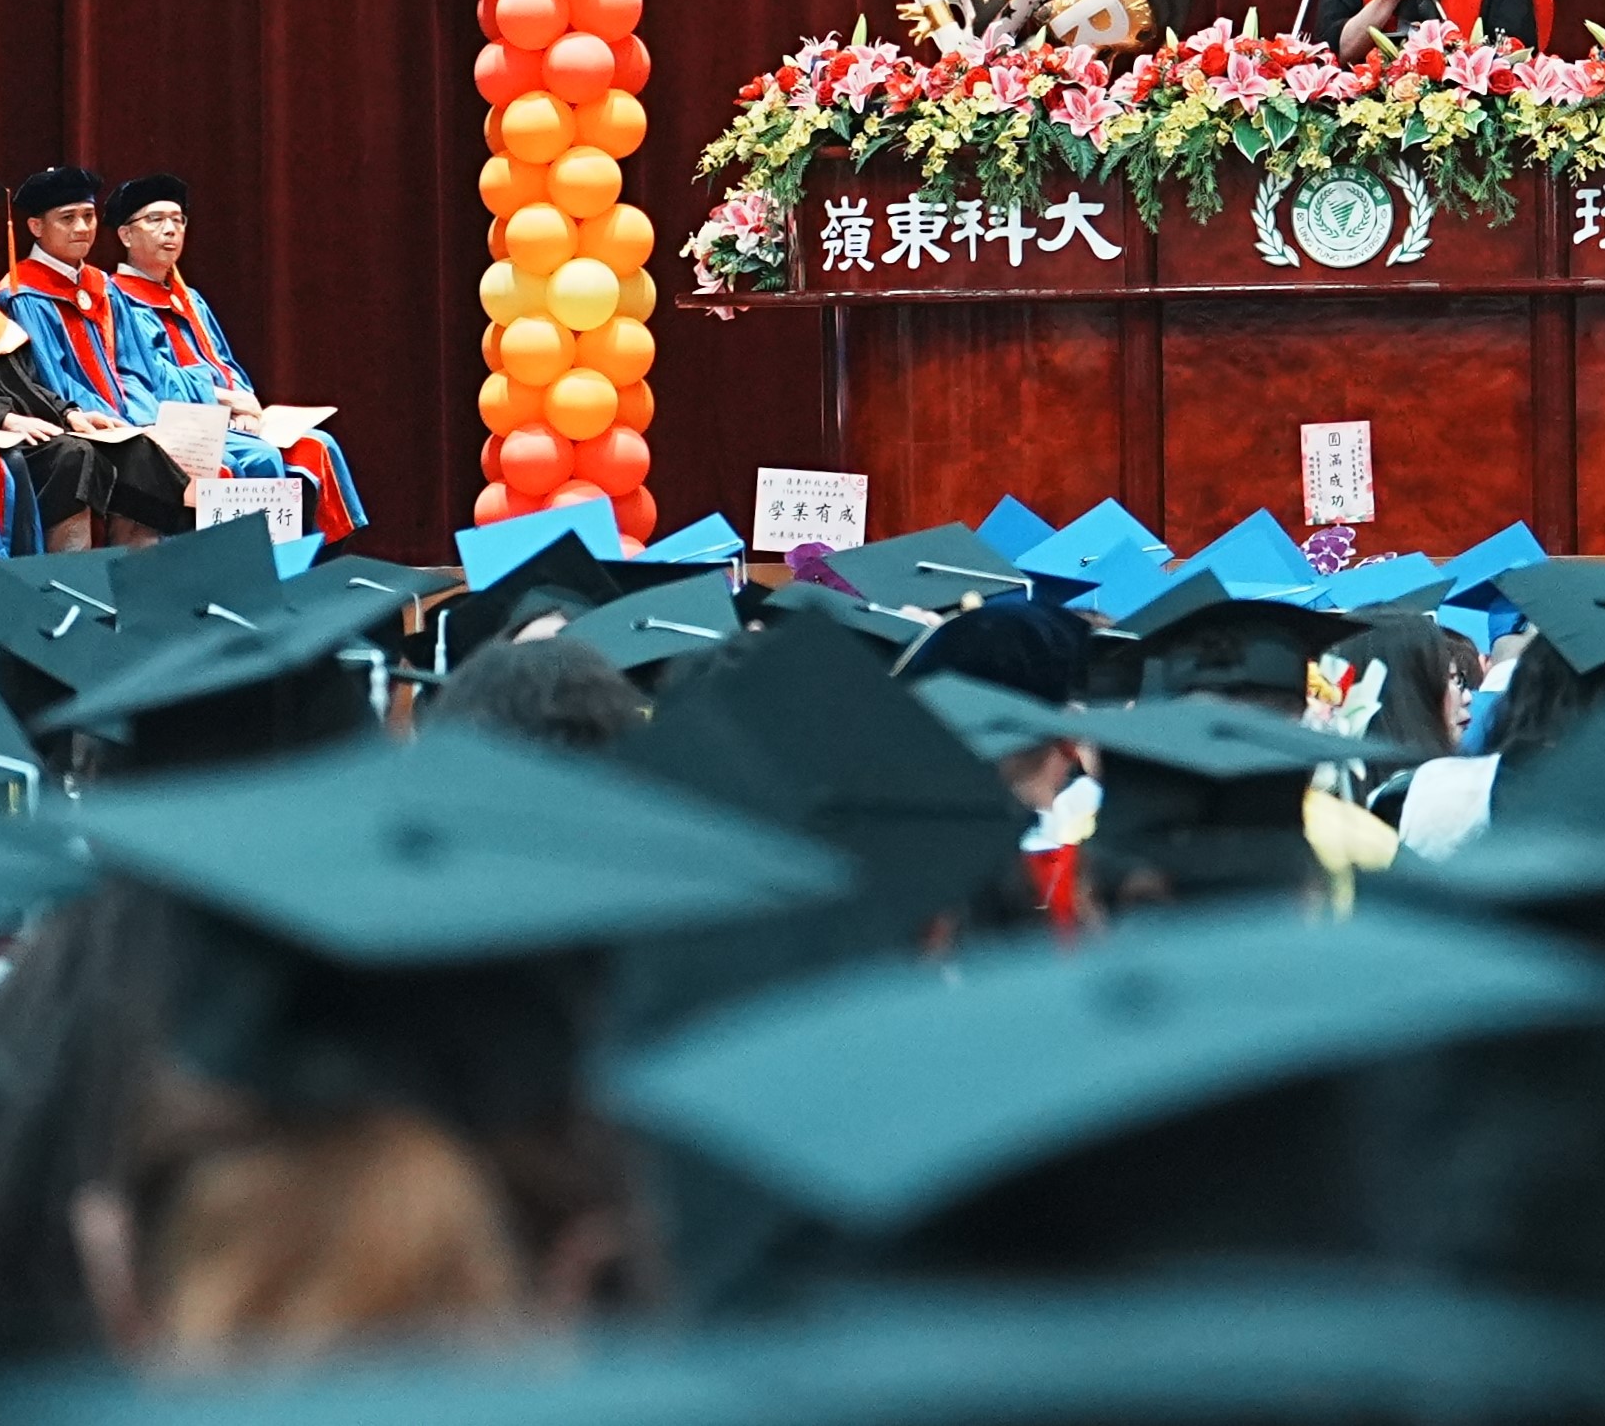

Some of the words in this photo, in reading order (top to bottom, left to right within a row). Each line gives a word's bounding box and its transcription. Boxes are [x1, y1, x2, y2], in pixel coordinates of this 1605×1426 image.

[821, 191, 1123, 272] 嶺東科大
[768, 500, 856, 525] 學業有成
